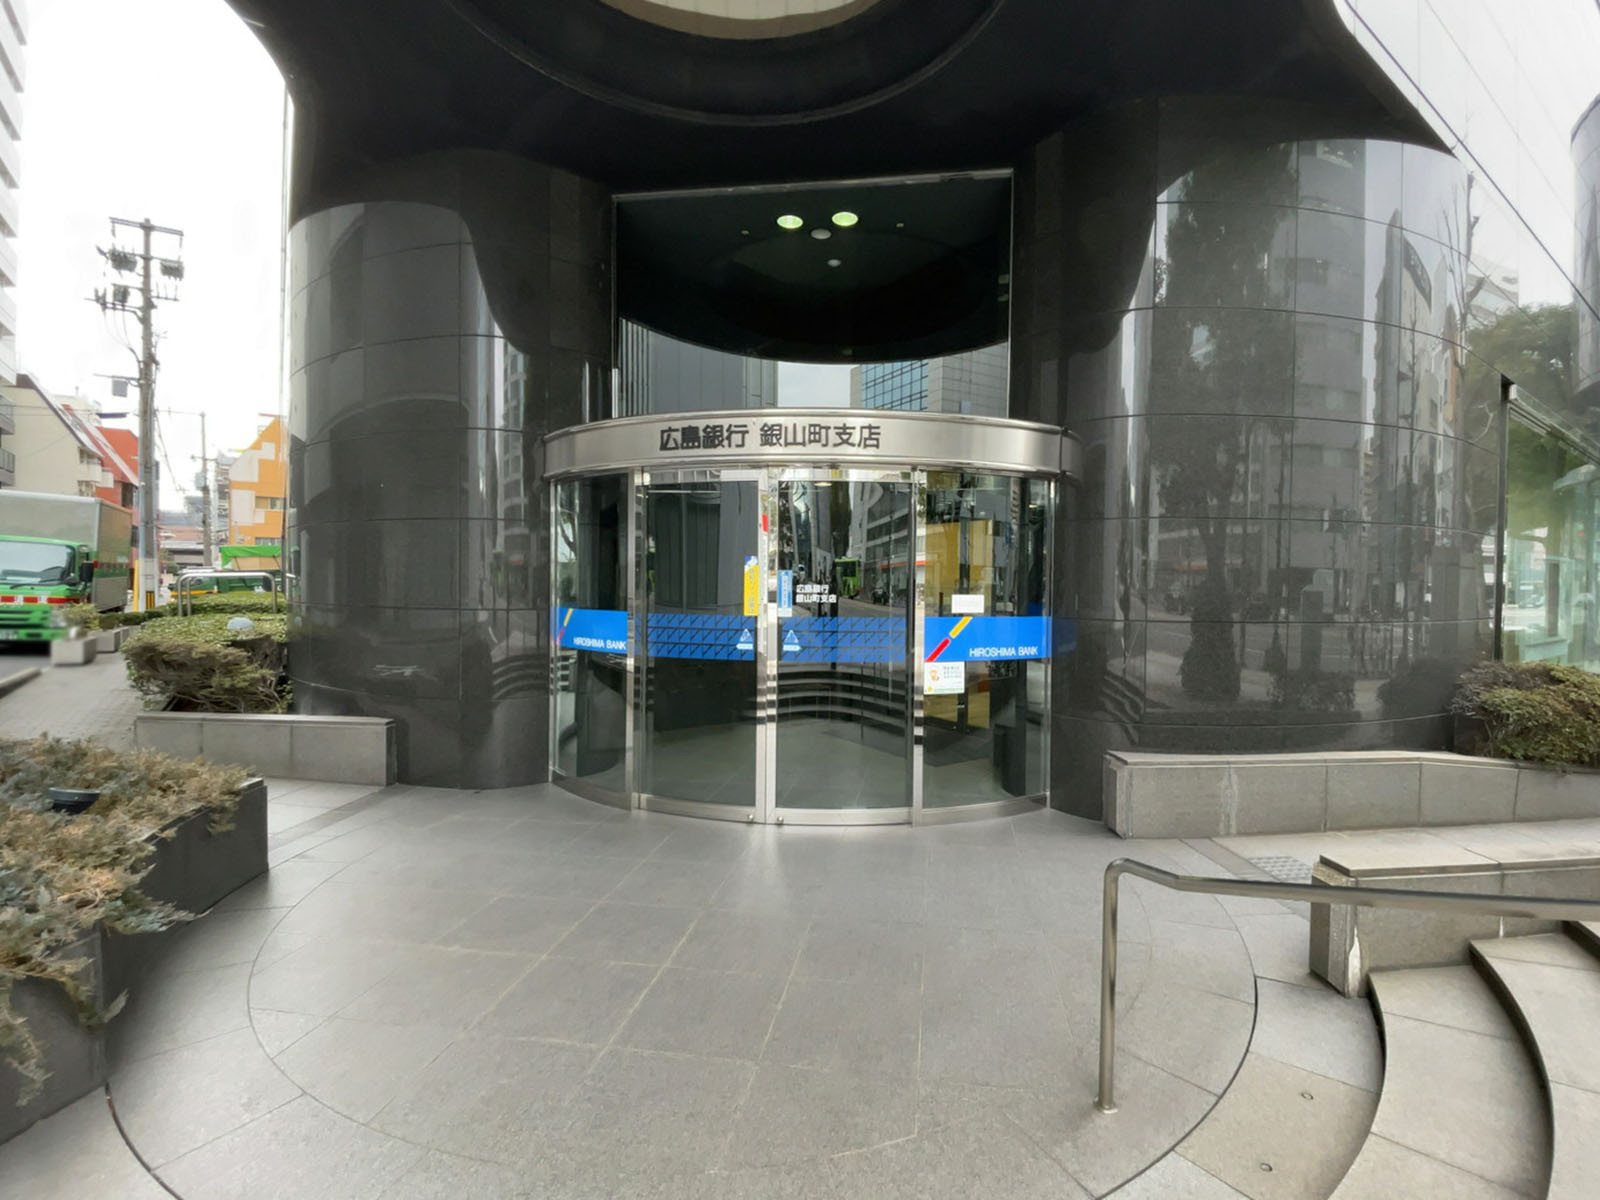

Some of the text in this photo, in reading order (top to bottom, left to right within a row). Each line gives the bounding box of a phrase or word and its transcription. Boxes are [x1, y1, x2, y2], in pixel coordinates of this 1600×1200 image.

[659, 423, 881, 451] 広島銀行 銀山町支店
[573, 636, 627, 650] HIROSHIMA BANK
[969, 646, 1038, 658] HIROSHIMA BANK
